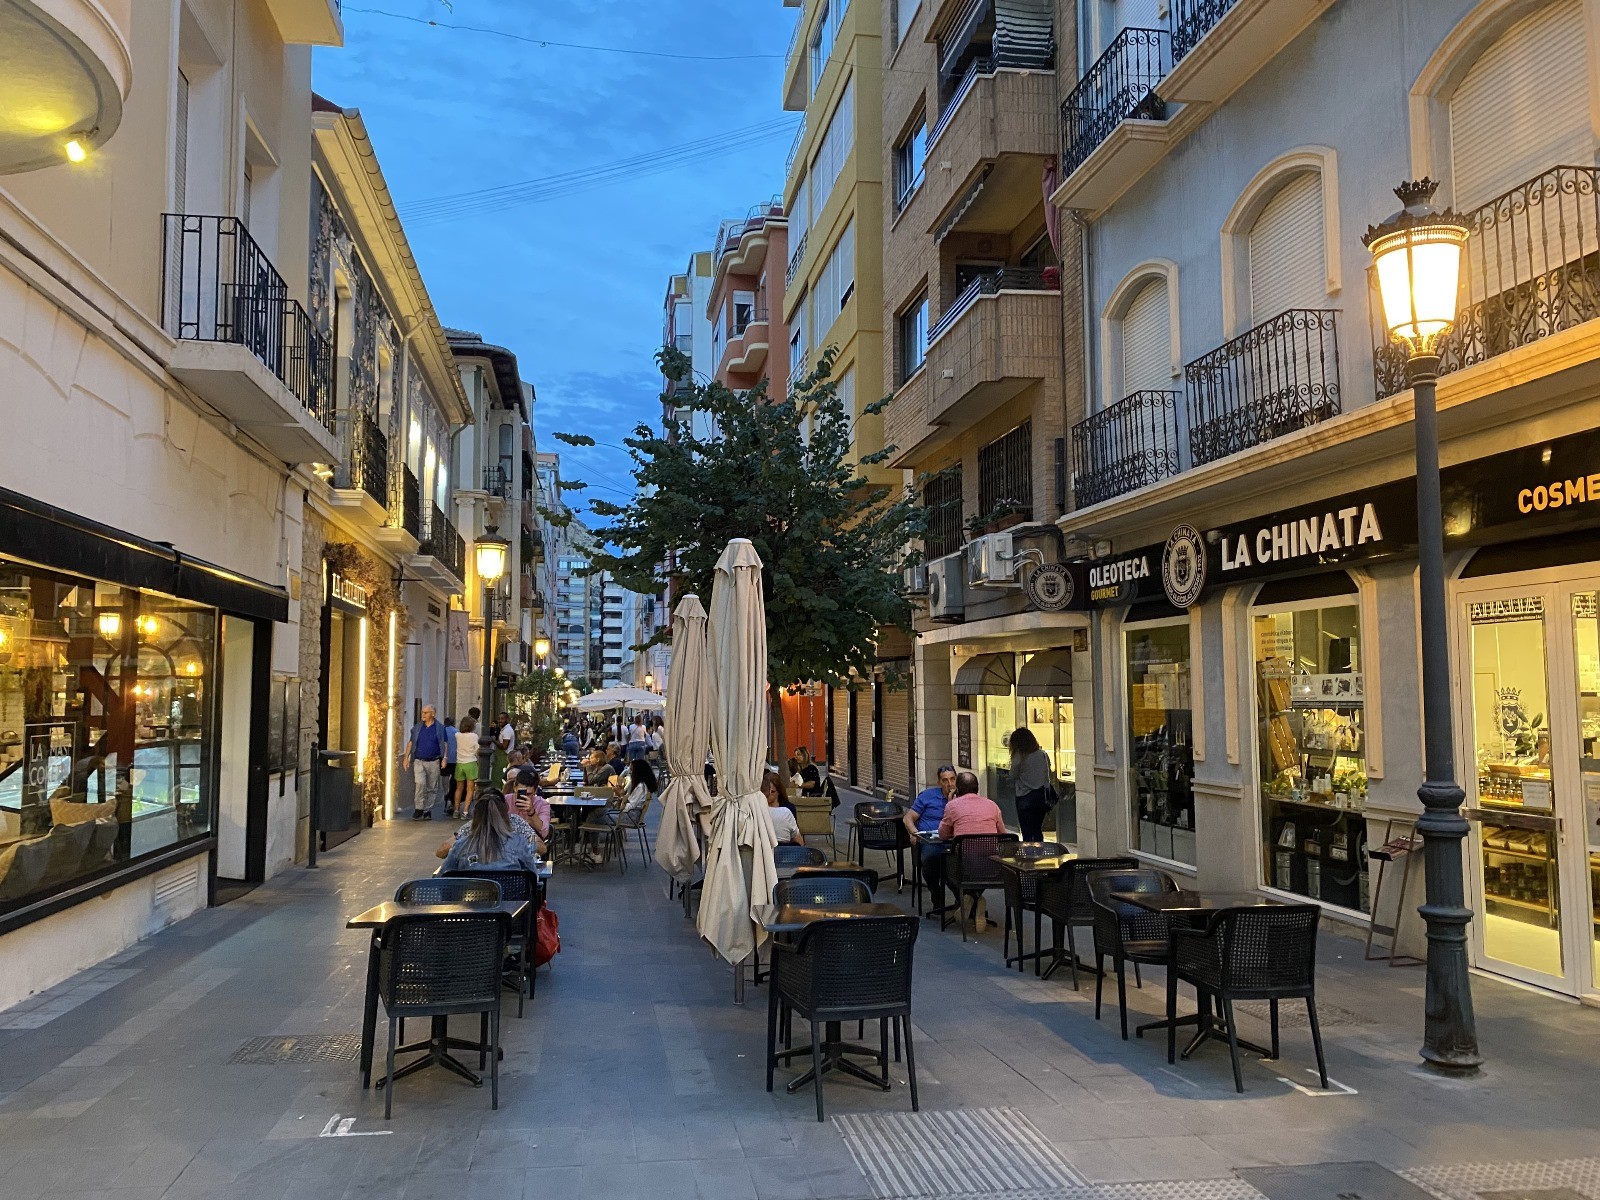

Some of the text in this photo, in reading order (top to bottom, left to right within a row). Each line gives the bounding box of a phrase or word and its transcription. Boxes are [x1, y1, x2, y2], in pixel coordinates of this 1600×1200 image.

[1173, 527, 1197, 545] CHINATA
[1221, 503, 1383, 571] LA CHINATA
[1089, 556, 1150, 588] OLEOTECA
[1090, 586, 1119, 601] GOURMET
[31, 744, 43, 762] LA
